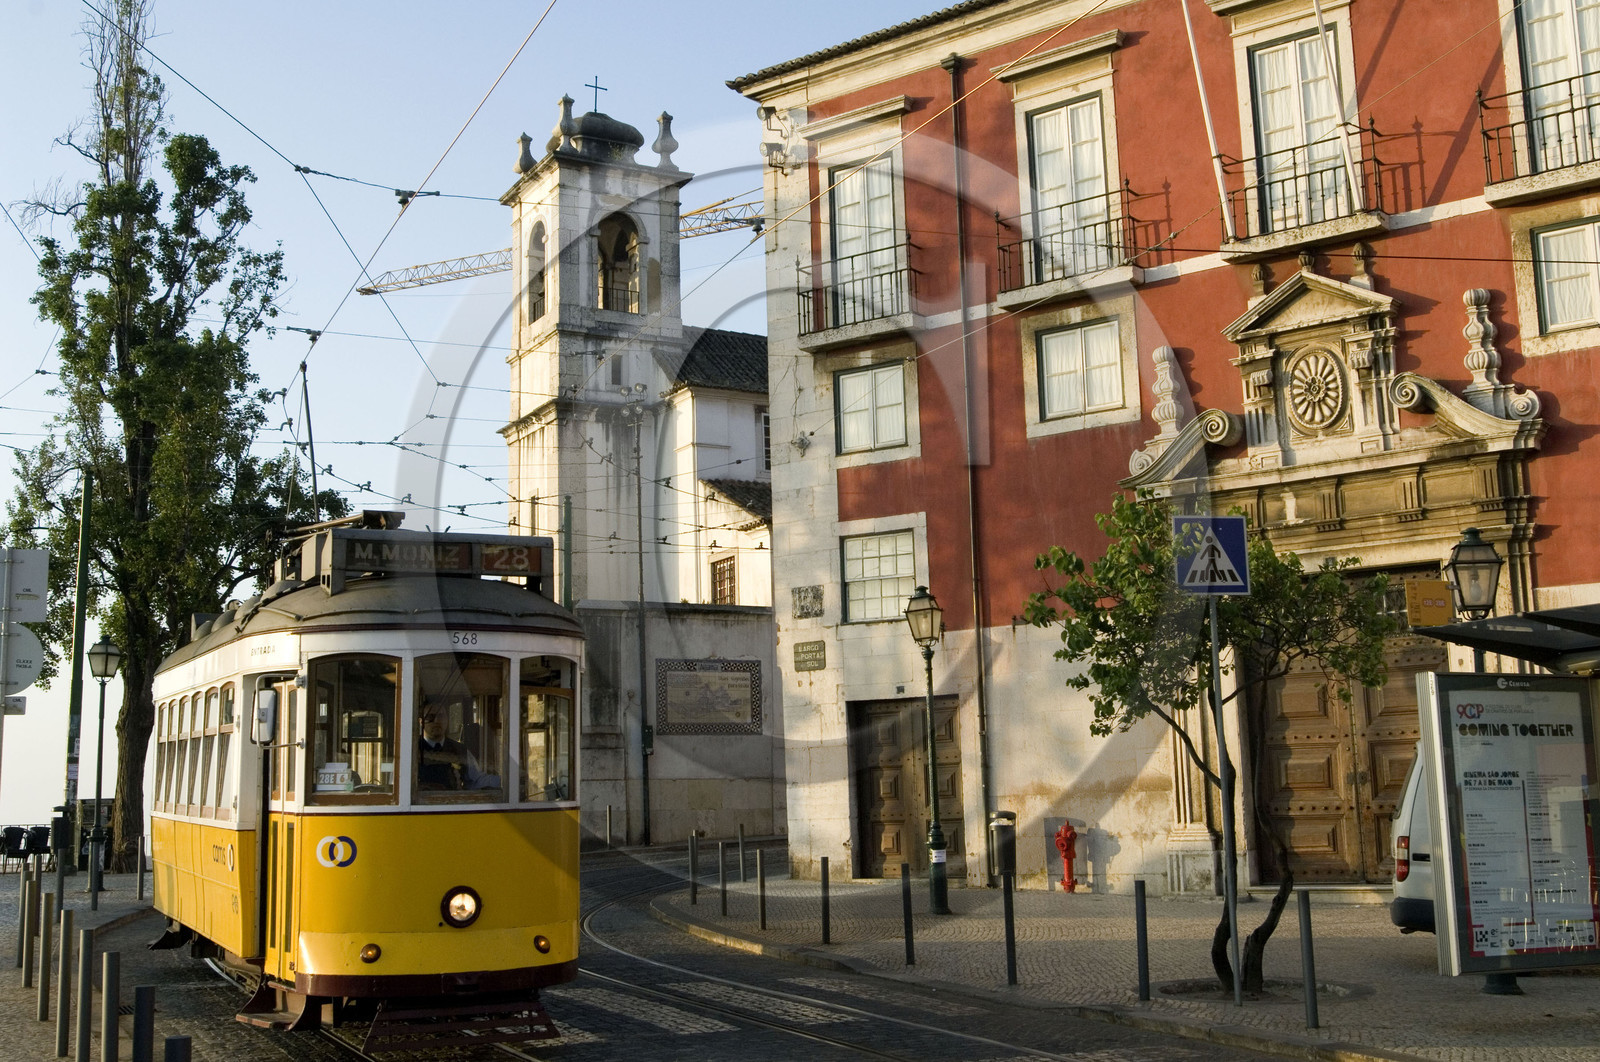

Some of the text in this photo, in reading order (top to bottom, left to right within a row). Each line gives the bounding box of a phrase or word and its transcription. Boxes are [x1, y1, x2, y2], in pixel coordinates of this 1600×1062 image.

[493, 546, 530, 570] 28
[452, 631, 478, 645] 568
[250, 645, 276, 657] ENTRADA
[800, 651, 824, 660] PORTAS
[1512, 723, 1574, 736] TOGETHER
[318, 773, 335, 784] 28E
